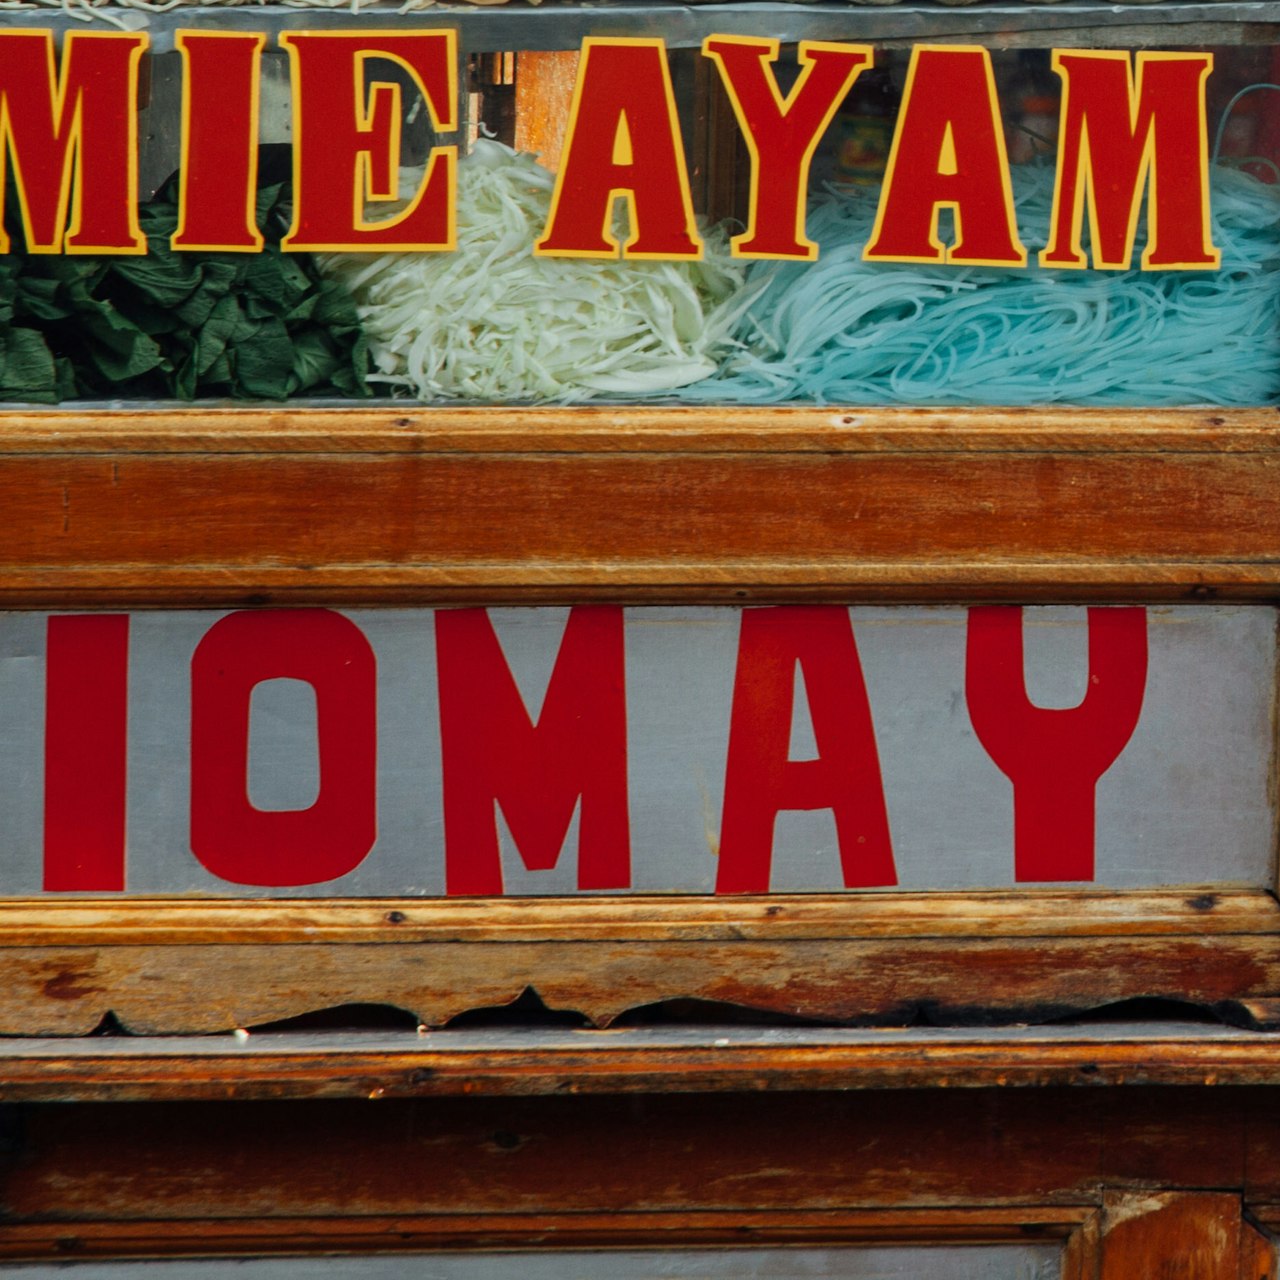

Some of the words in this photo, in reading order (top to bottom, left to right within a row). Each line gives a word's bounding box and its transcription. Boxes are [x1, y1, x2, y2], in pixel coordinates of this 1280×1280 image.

[0, 27, 458, 255] MIE
[534, 34, 1221, 271] AYAM
[43, 604, 1148, 896] IOMAY
